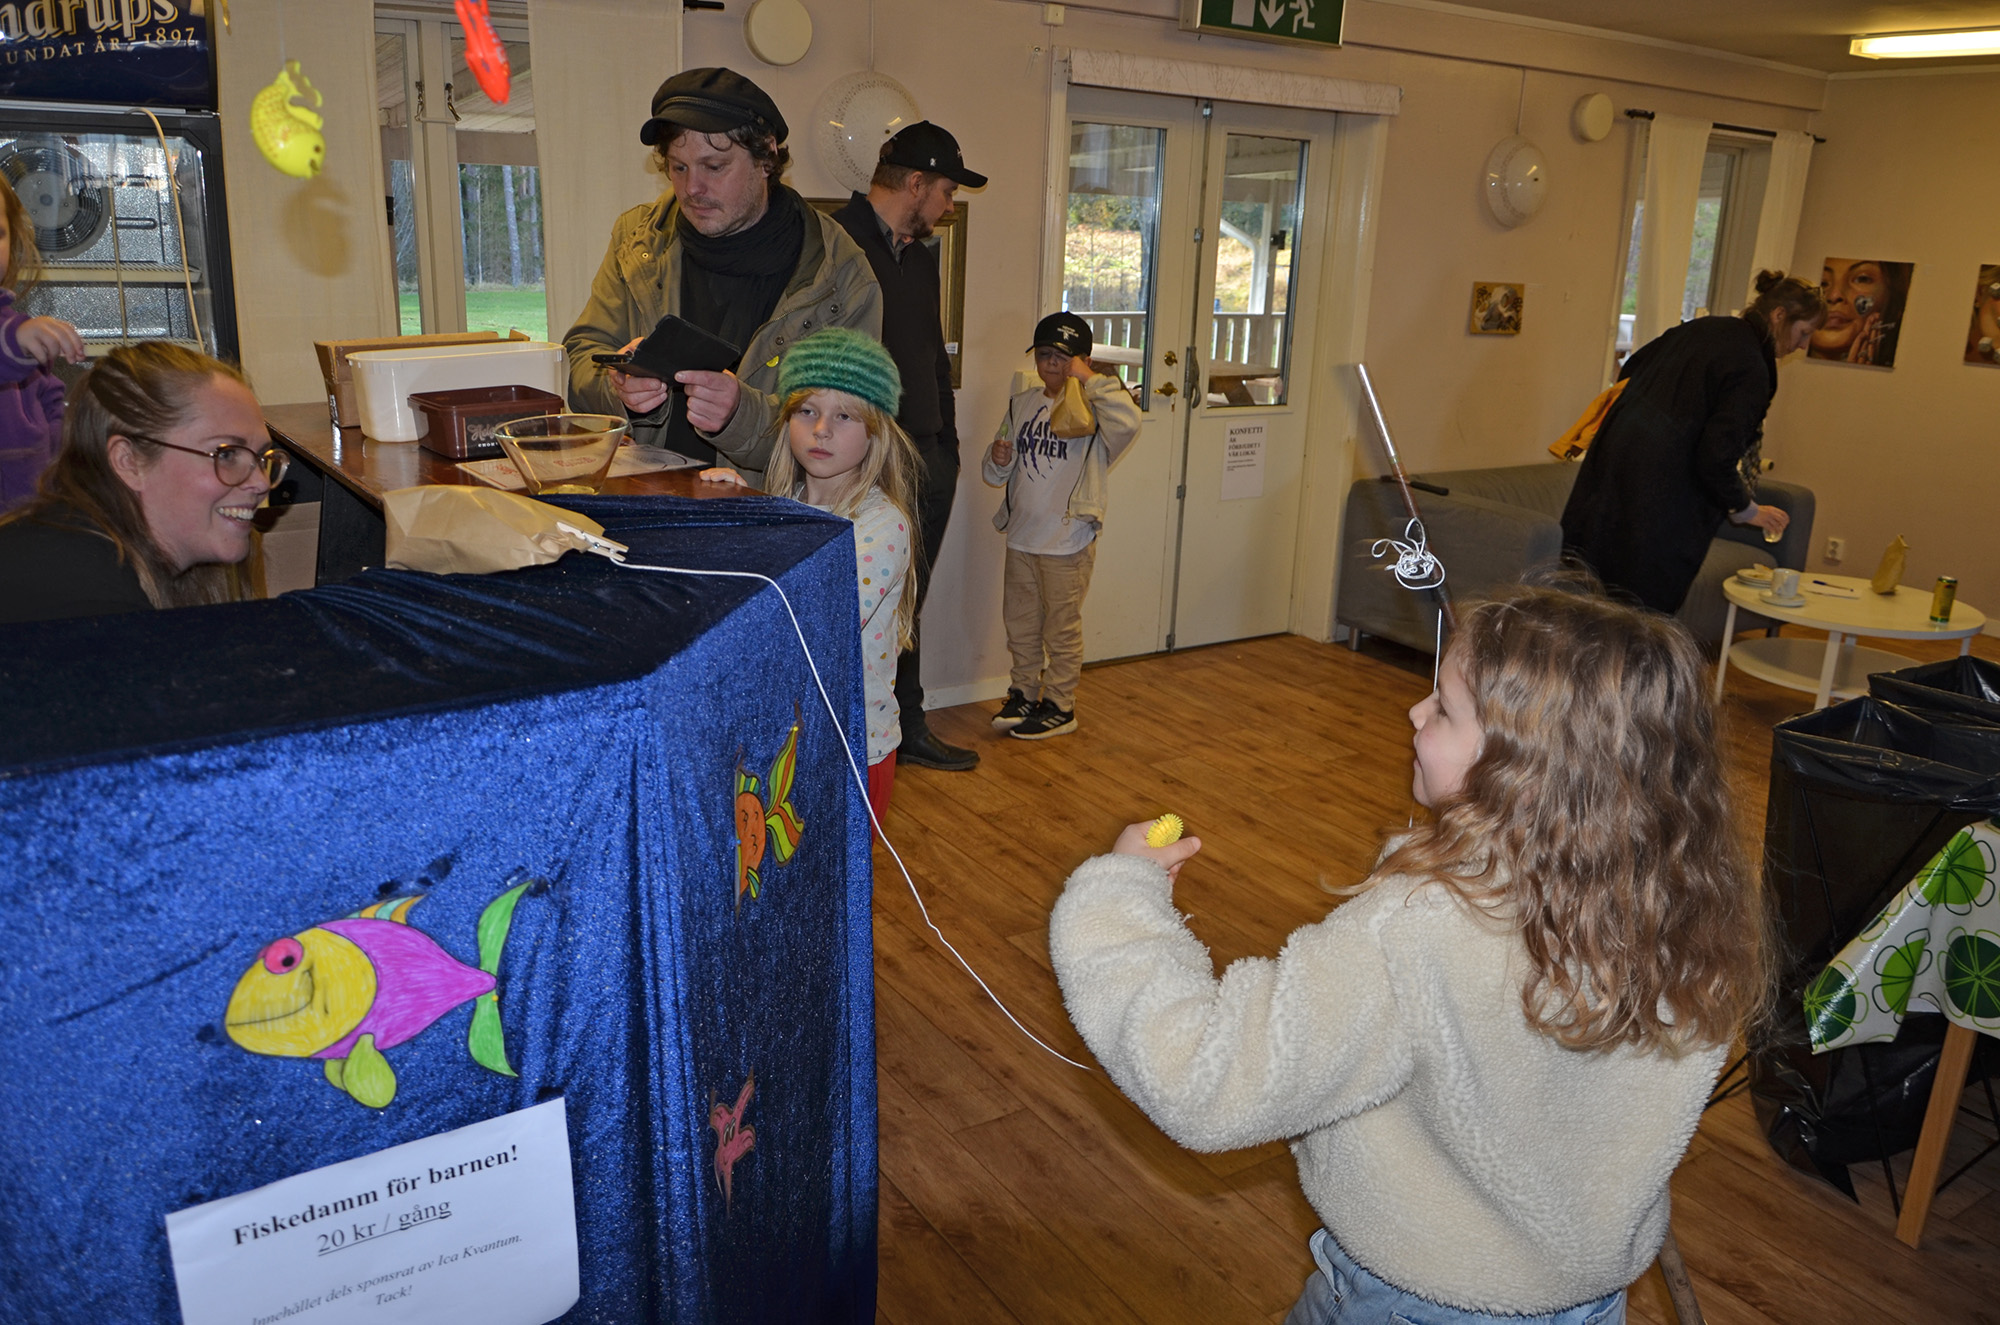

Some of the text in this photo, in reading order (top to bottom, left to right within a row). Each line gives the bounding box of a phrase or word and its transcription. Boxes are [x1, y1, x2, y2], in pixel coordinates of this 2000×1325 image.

[0, 27, 195, 64] UNDAT ÅR 1897
[1229, 427, 1263, 435] KONFETTI
[233, 1144, 518, 1246] Fiskedamm för barnen!
[316, 1228, 346, 1254] 20
[352, 1222, 377, 1241] kr
[398, 1201, 452, 1230] gång
[252, 1235, 522, 1325] Innehållet dels sponsrat av Ica Kvantum.
[375, 1284, 413, 1306] Tack!
